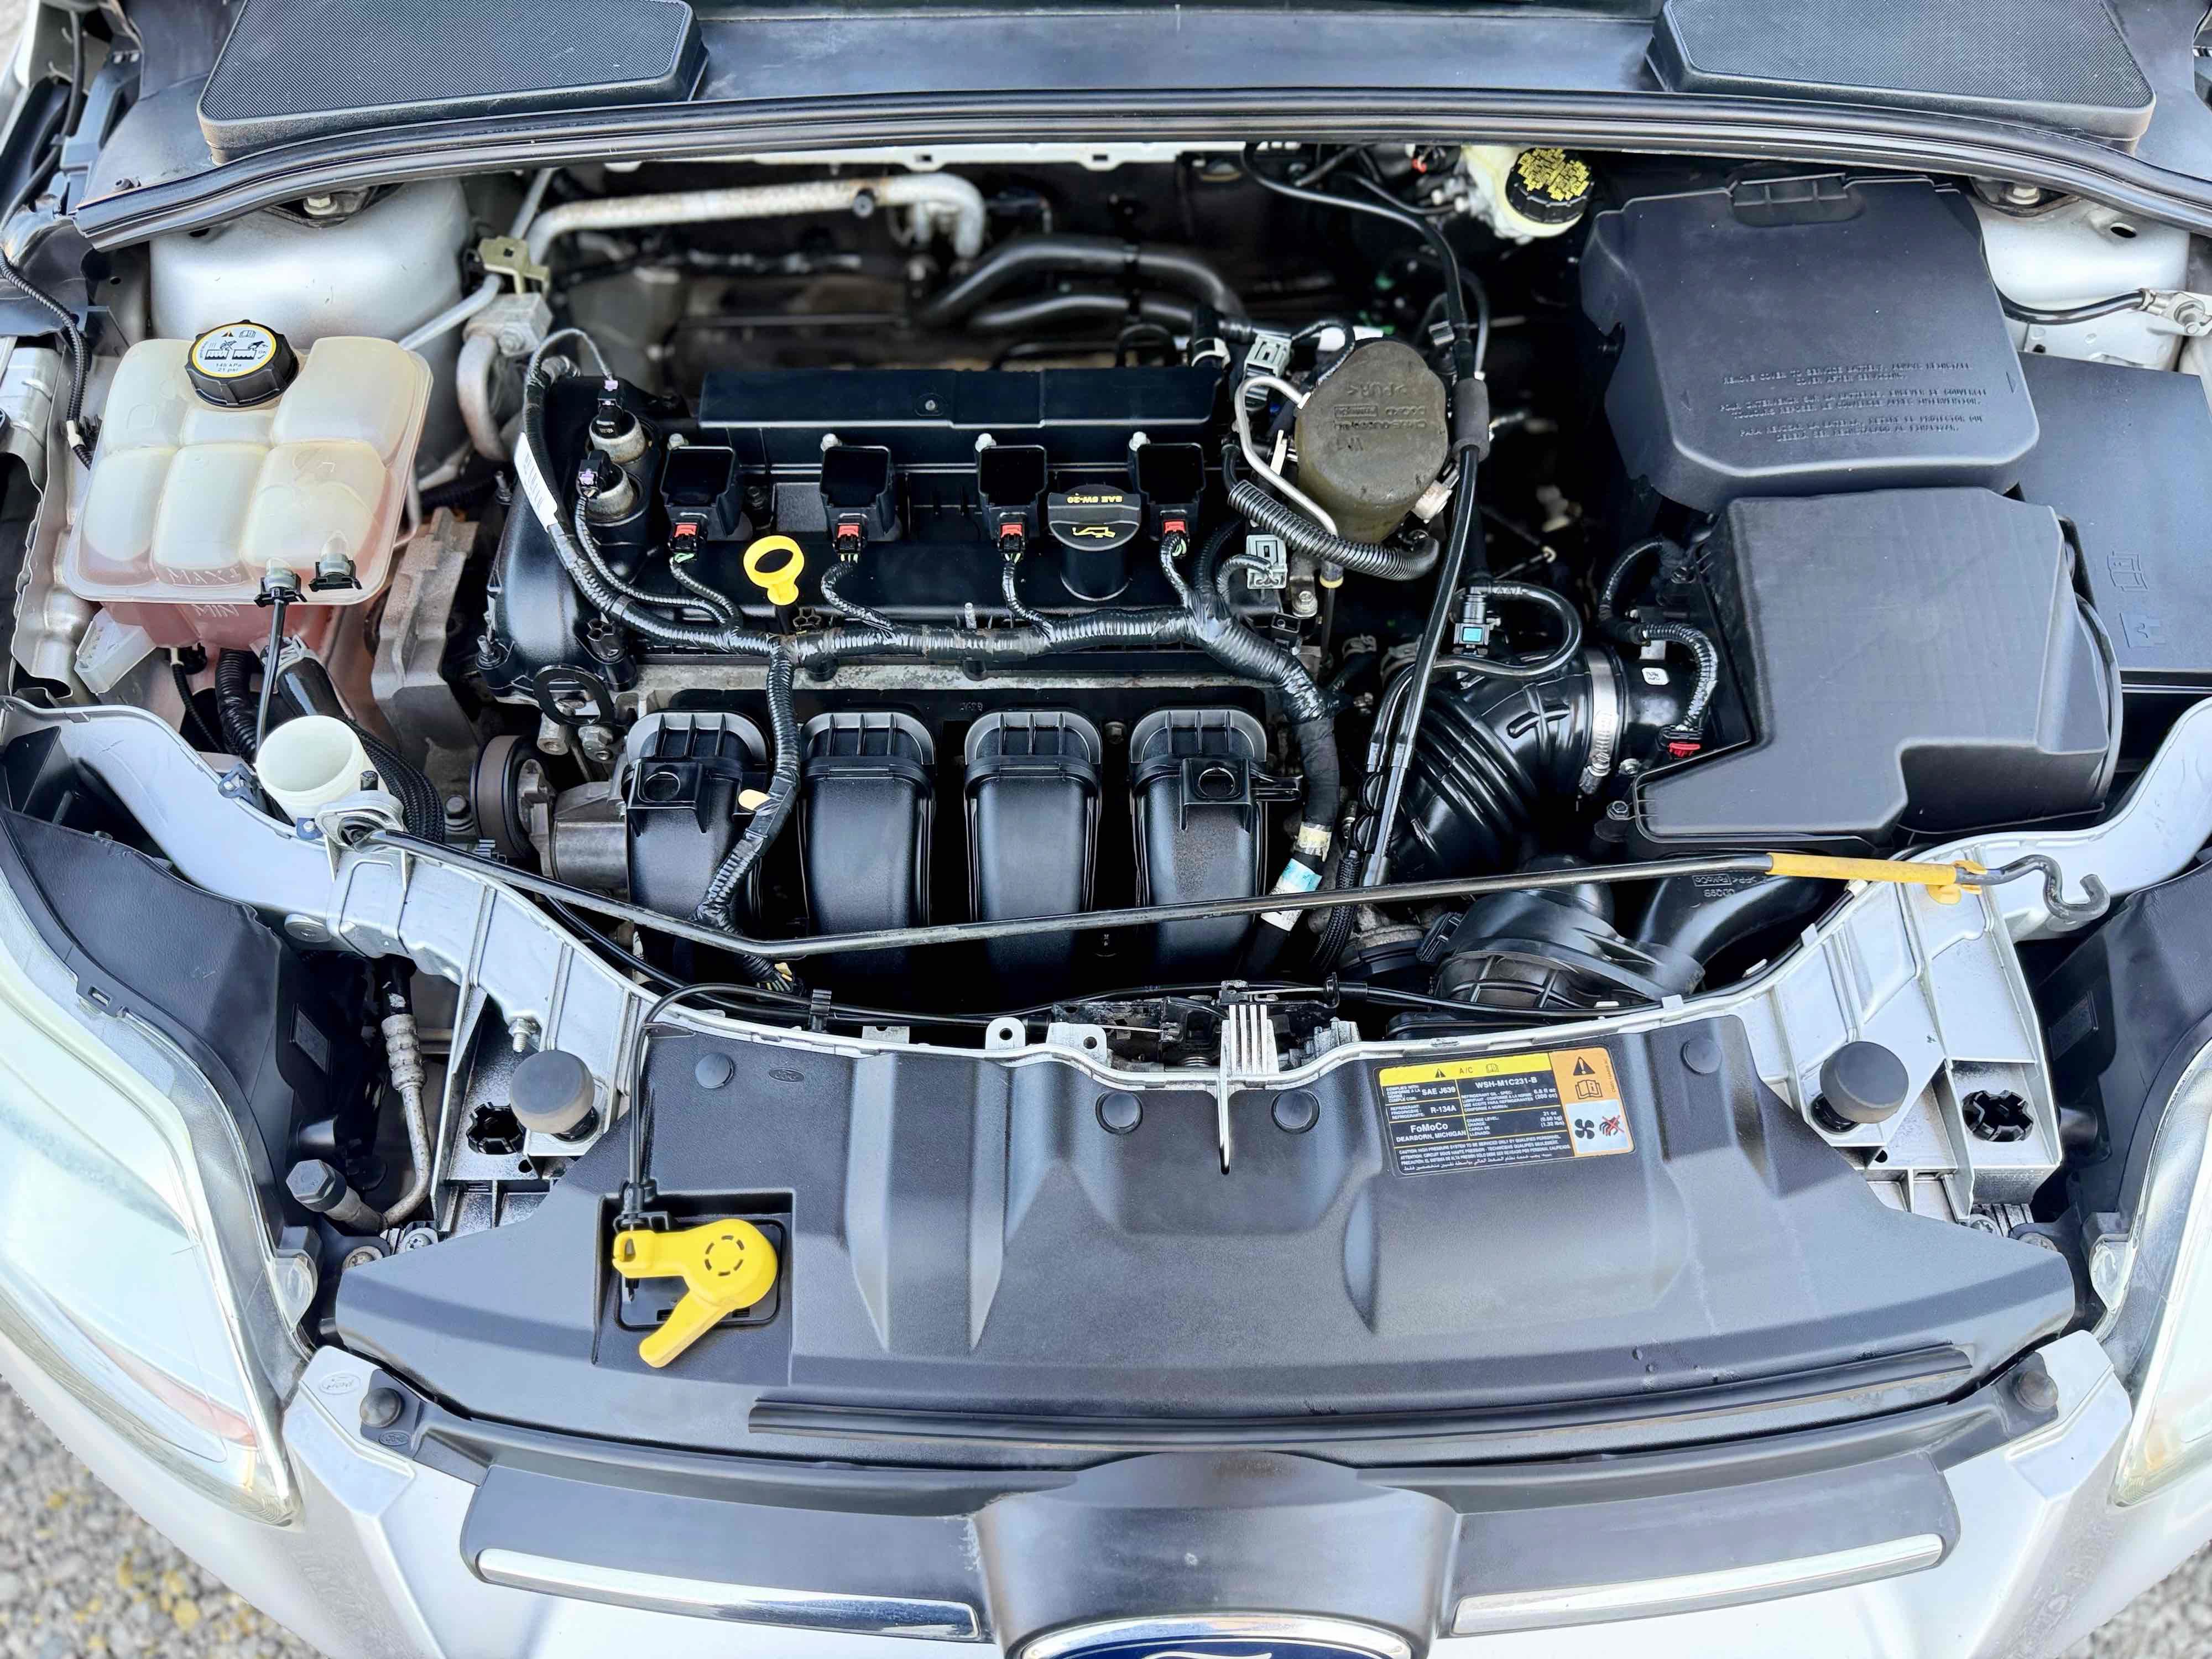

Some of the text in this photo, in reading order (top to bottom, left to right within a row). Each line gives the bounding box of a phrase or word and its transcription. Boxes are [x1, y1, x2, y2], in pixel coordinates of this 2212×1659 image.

[167, 567, 229, 585] MAX
[191, 604, 239, 618] MIN
[774, 1070, 797, 1081] Ford
[1475, 1076, 1537, 1088] WSH-M1C231-B
[1430, 1105, 1456, 1113] R-134A
[1410, 1121, 1448, 1133] FoMoCo
[1396, 1130, 1466, 1142] DEARBORN, MICHIGAN
